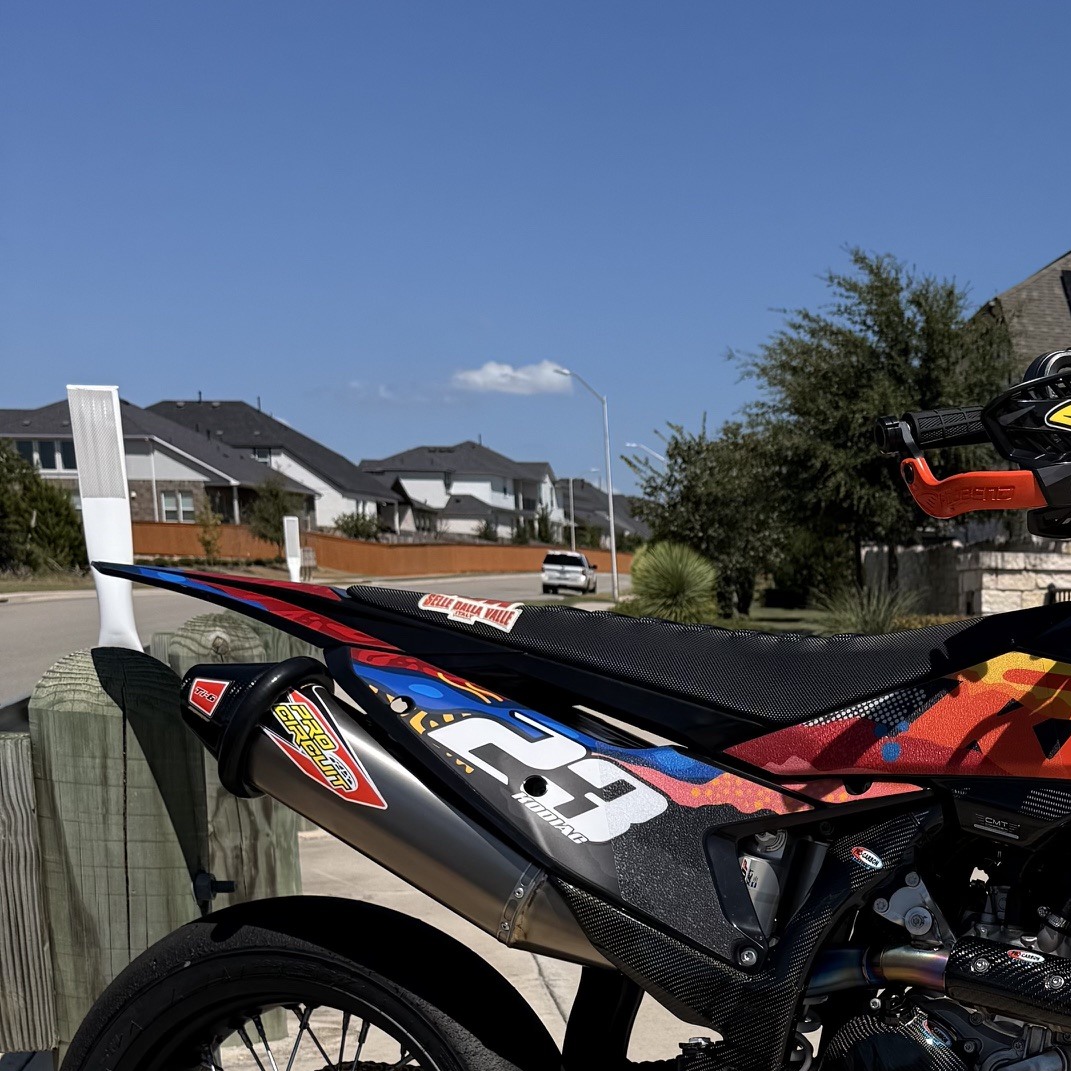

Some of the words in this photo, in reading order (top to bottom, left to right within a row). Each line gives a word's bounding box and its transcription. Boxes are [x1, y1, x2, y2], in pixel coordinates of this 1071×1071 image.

[422, 593, 455, 608] SELLE
[452, 601, 483, 615] DALLA
[485, 607, 515, 626] VALLE
[273, 705, 350, 791] CIRCUIT
[291, 704, 336, 751] PRO
[427, 717, 668, 842] 23
[511, 791, 590, 844] KODIAC
[985, 816, 1008, 827] CMT
